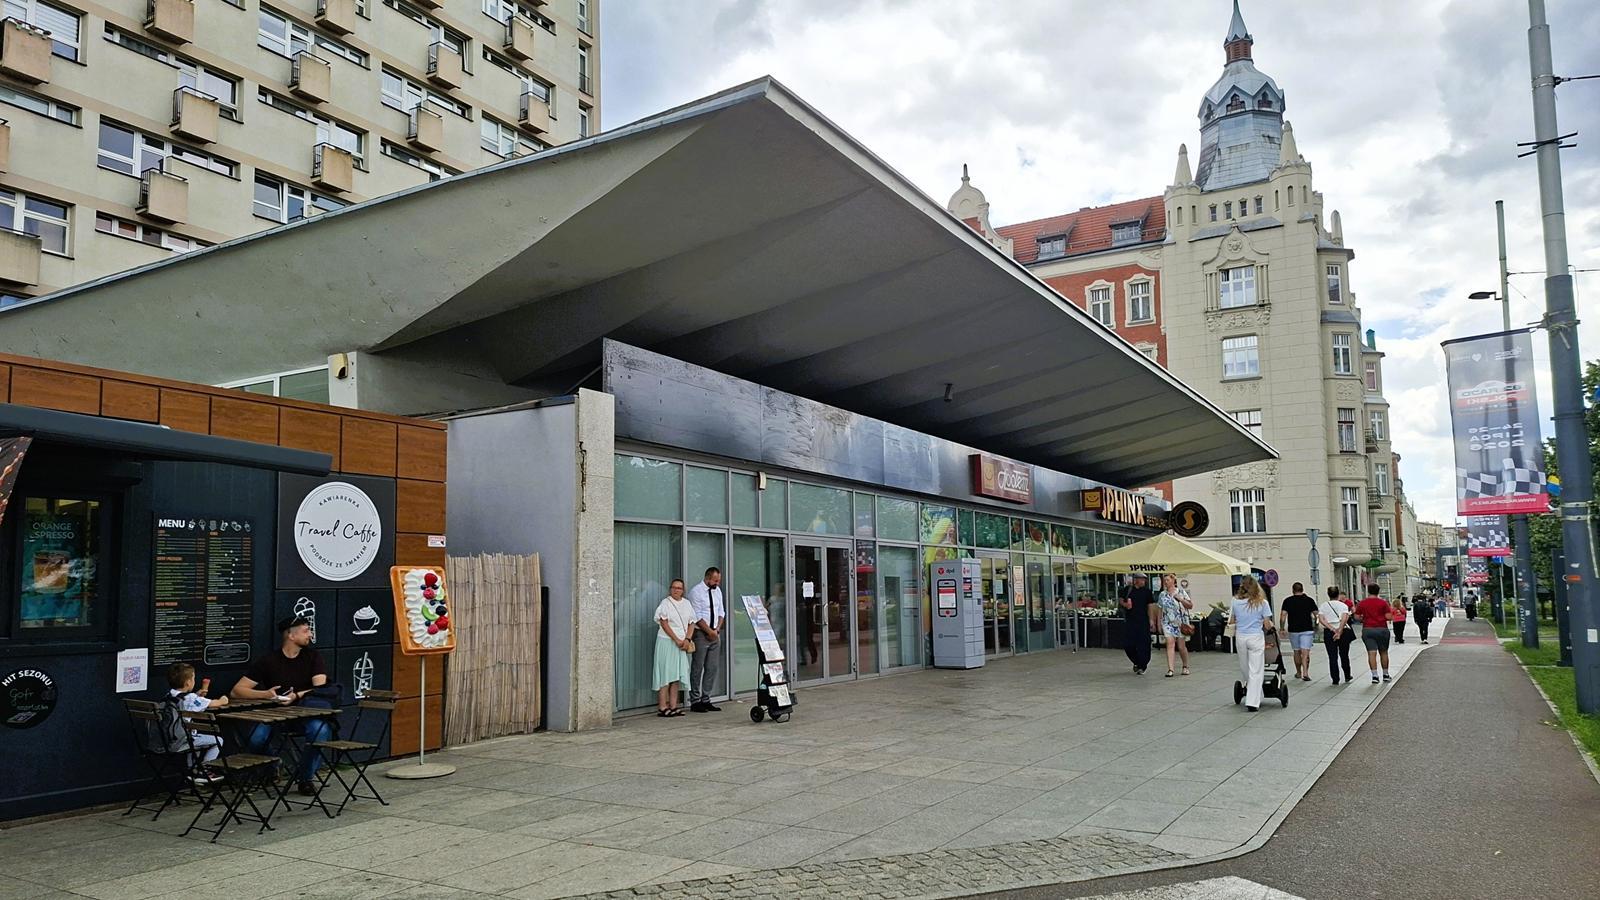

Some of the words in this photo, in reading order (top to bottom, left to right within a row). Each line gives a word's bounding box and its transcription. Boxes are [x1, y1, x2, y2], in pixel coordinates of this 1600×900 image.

[319, 495, 360, 509] KAWIARENKA
[1101, 487, 1145, 526] SPHINX
[32, 522, 72, 531] ORANGE
[158, 519, 186, 528] MENU
[298, 519, 340, 537] Travel
[342, 523, 378, 543] Caffe
[344, 545, 367, 567] SMAKIEM
[1, 673, 17, 687] HIT
[18, 669, 53, 687] SEZONU
